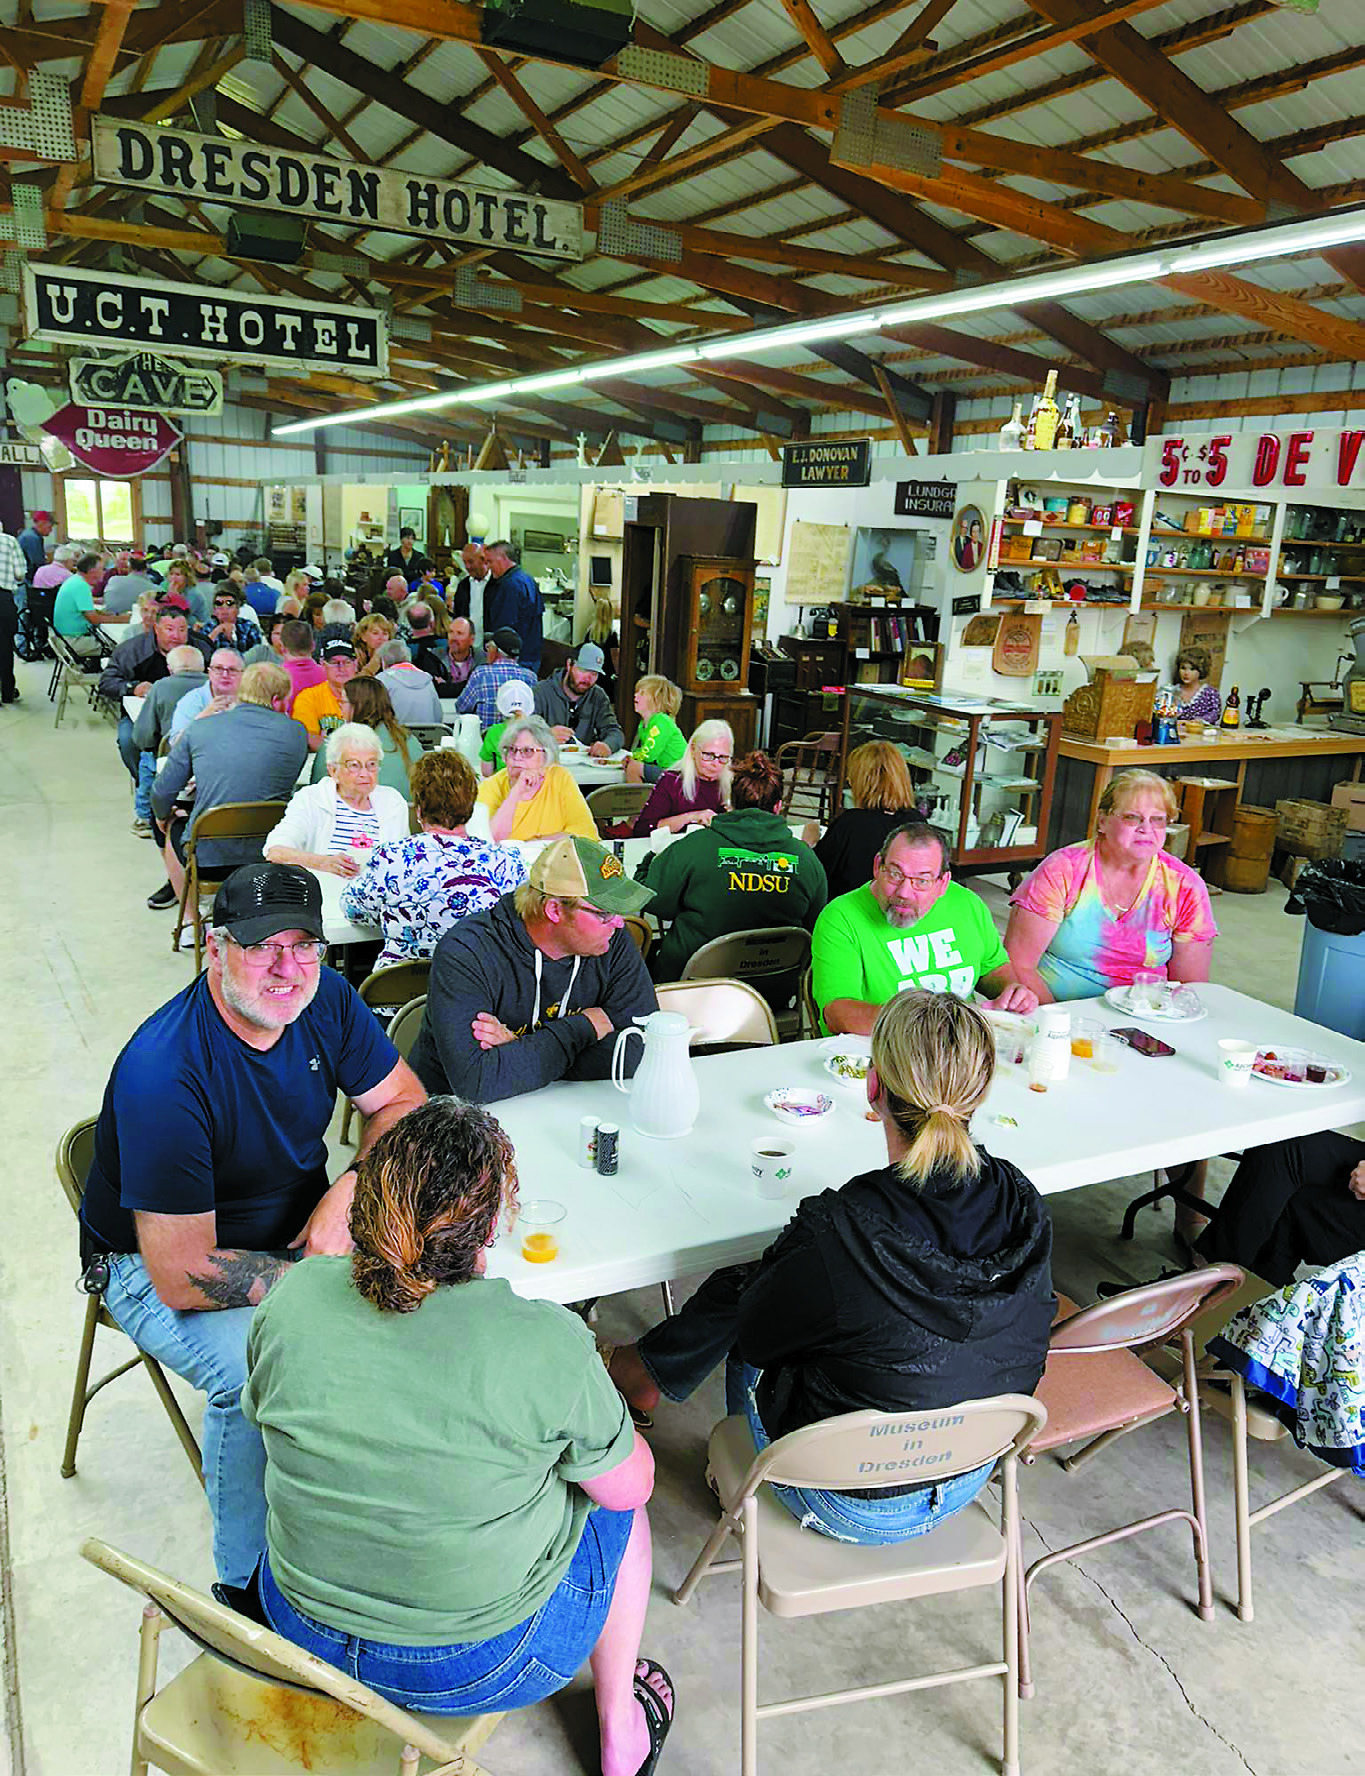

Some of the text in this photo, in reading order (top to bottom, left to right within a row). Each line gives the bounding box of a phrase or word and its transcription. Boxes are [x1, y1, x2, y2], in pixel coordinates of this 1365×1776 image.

[116, 127, 381, 220] DRESDEN
[200, 303, 371, 359] HOTEL
[132, 352, 164, 372] THE
[90, 369, 206, 406] CAVE
[87, 408, 158, 436] Dairy
[75, 427, 158, 452] Queen
[809, 446, 859, 463] DONOVAN
[1182, 469, 1201, 485] TO
[1252, 431, 1314, 487] DE
[801, 465, 849, 480] LAWYER
[905, 497, 955, 512] INSURA
[728, 871, 790, 893] NDSU
[887, 927, 963, 976] WE
[869, 1415, 965, 1437] Museum
[903, 1439, 923, 1451] in
